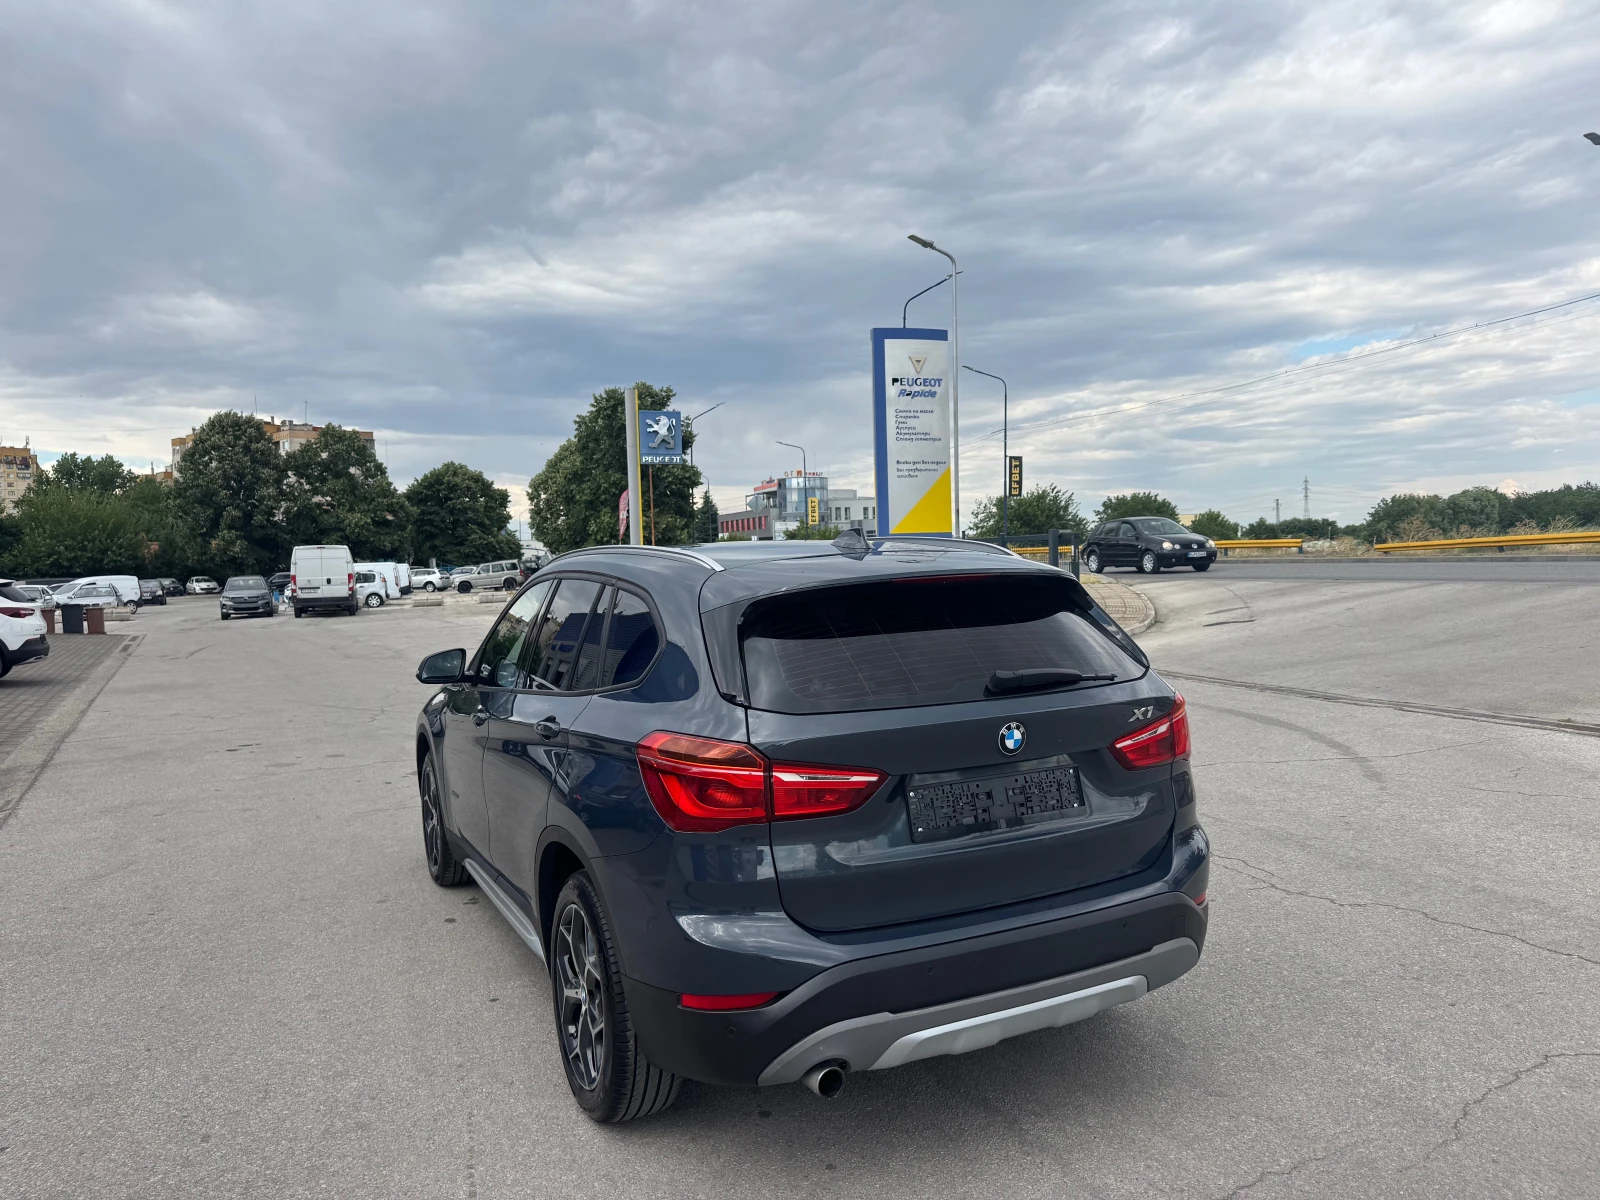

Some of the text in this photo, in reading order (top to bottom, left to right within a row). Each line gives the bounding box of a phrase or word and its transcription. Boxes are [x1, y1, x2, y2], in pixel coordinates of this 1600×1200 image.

[892, 378, 943, 388] PEUGEOT
[898, 389, 938, 399] Rapide
[1012, 459, 1020, 494] EFBET
[1128, 706, 1154, 722] X1
